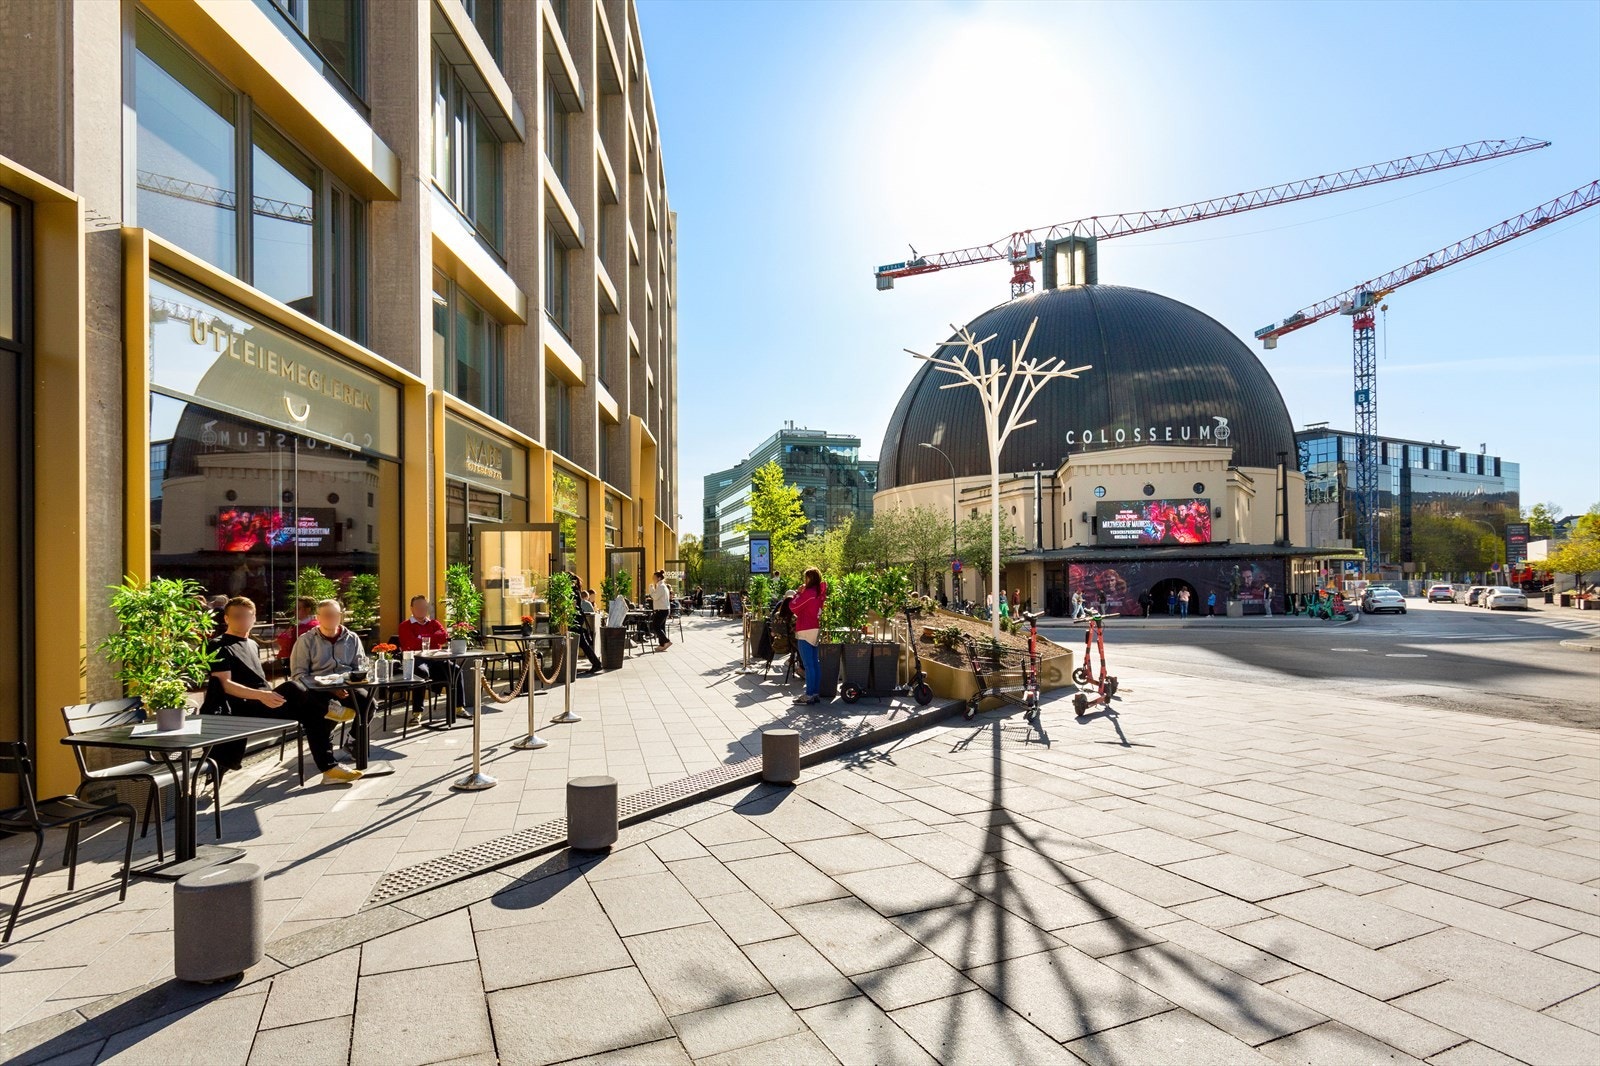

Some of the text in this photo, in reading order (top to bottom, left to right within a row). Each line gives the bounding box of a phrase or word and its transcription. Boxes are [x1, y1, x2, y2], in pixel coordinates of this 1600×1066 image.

[190, 318, 373, 412] UTLEIEMEGLEREN
[1358, 394, 1366, 402] B
[1066, 425, 1210, 444] COLOSSEUM
